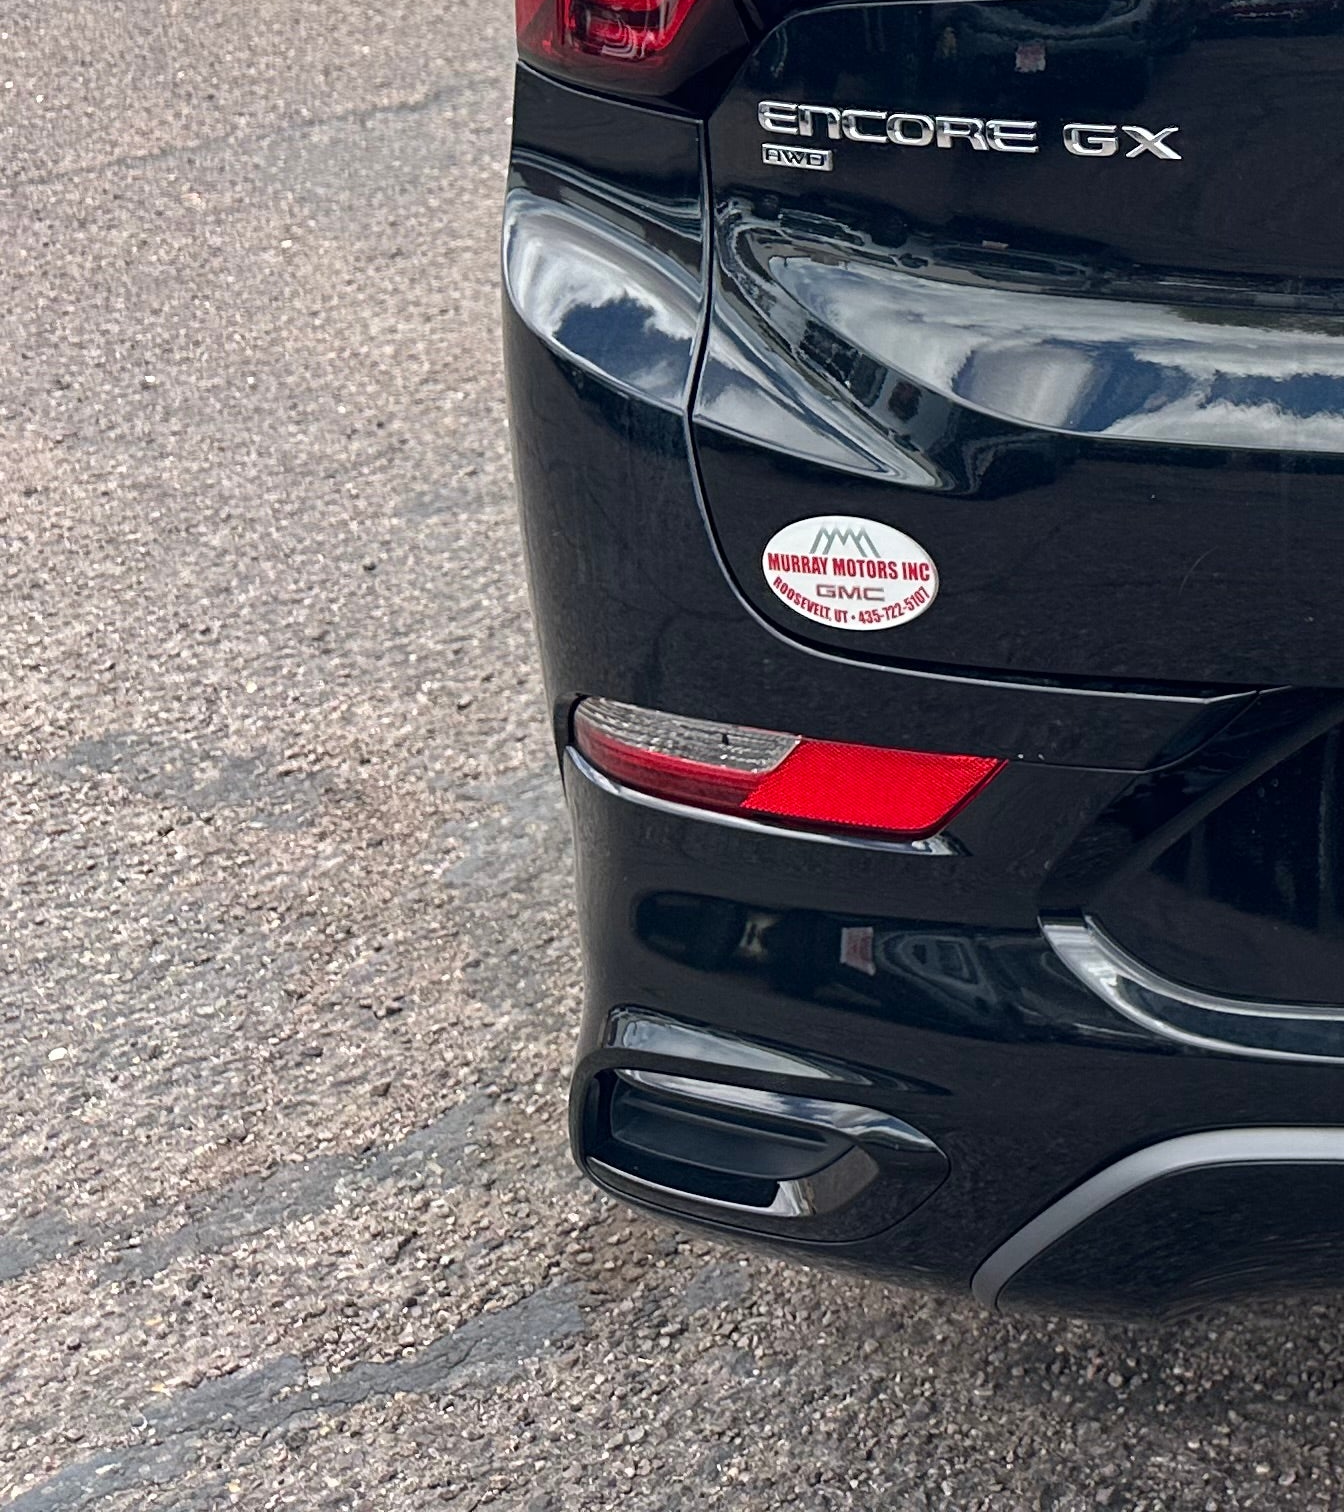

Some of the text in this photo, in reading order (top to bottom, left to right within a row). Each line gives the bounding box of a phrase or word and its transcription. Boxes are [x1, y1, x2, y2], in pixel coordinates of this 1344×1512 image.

[757, 99, 1182, 160] ENCORE GX
[764, 146, 827, 169] AWD
[767, 552, 931, 582] MURRAY MOTORS INC
[816, 583, 885, 602] GMC
[834, 608, 849, 624] UT
[858, 585, 931, 625] 435-722-5107
